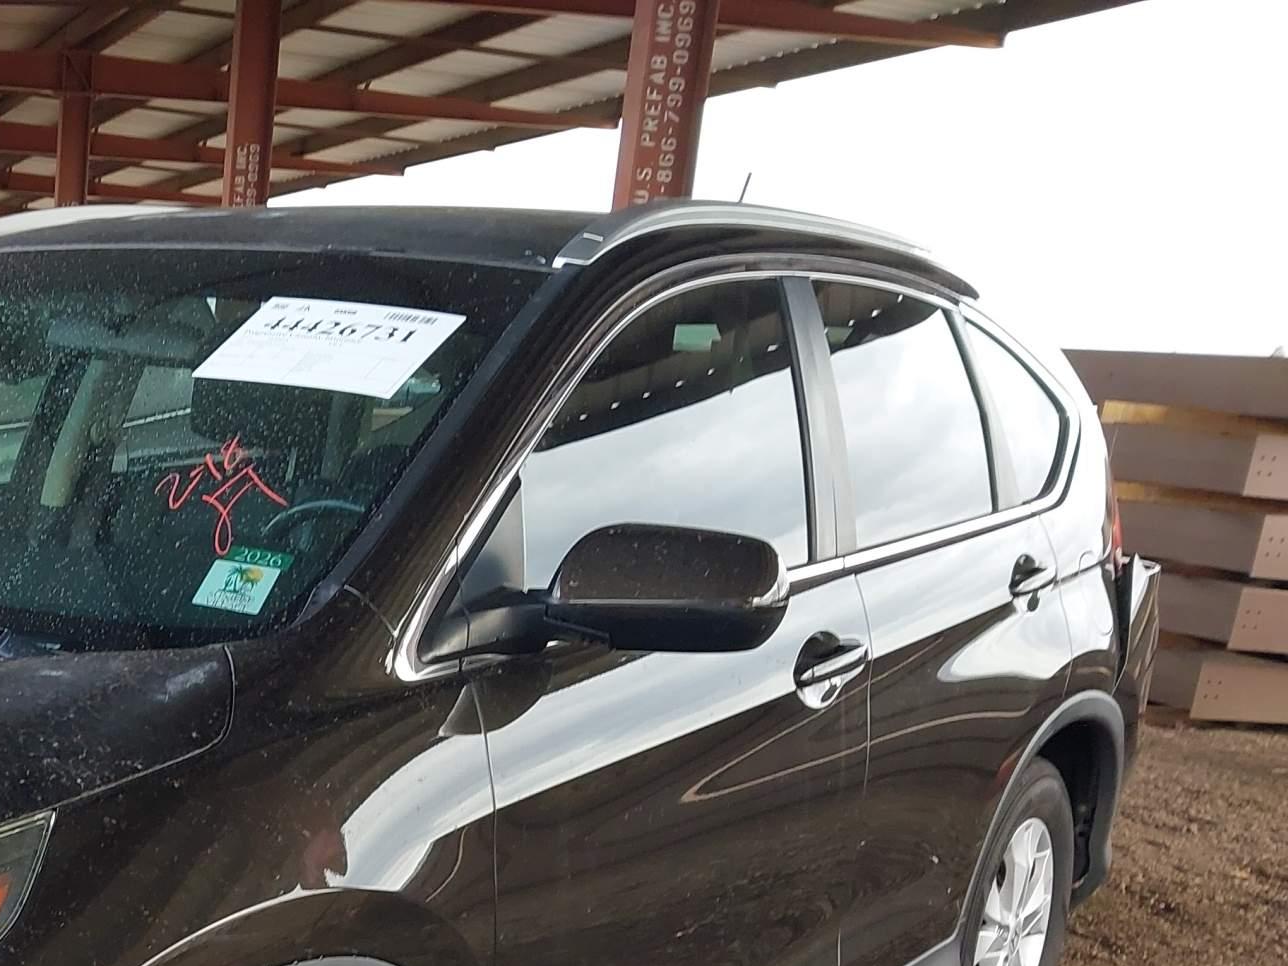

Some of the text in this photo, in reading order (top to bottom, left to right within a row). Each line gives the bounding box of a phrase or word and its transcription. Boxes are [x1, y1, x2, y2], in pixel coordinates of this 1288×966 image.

[640, 54, 668, 148] PREFAB
[264, 315, 418, 345] 44426731
[233, 546, 283, 566] 2026
